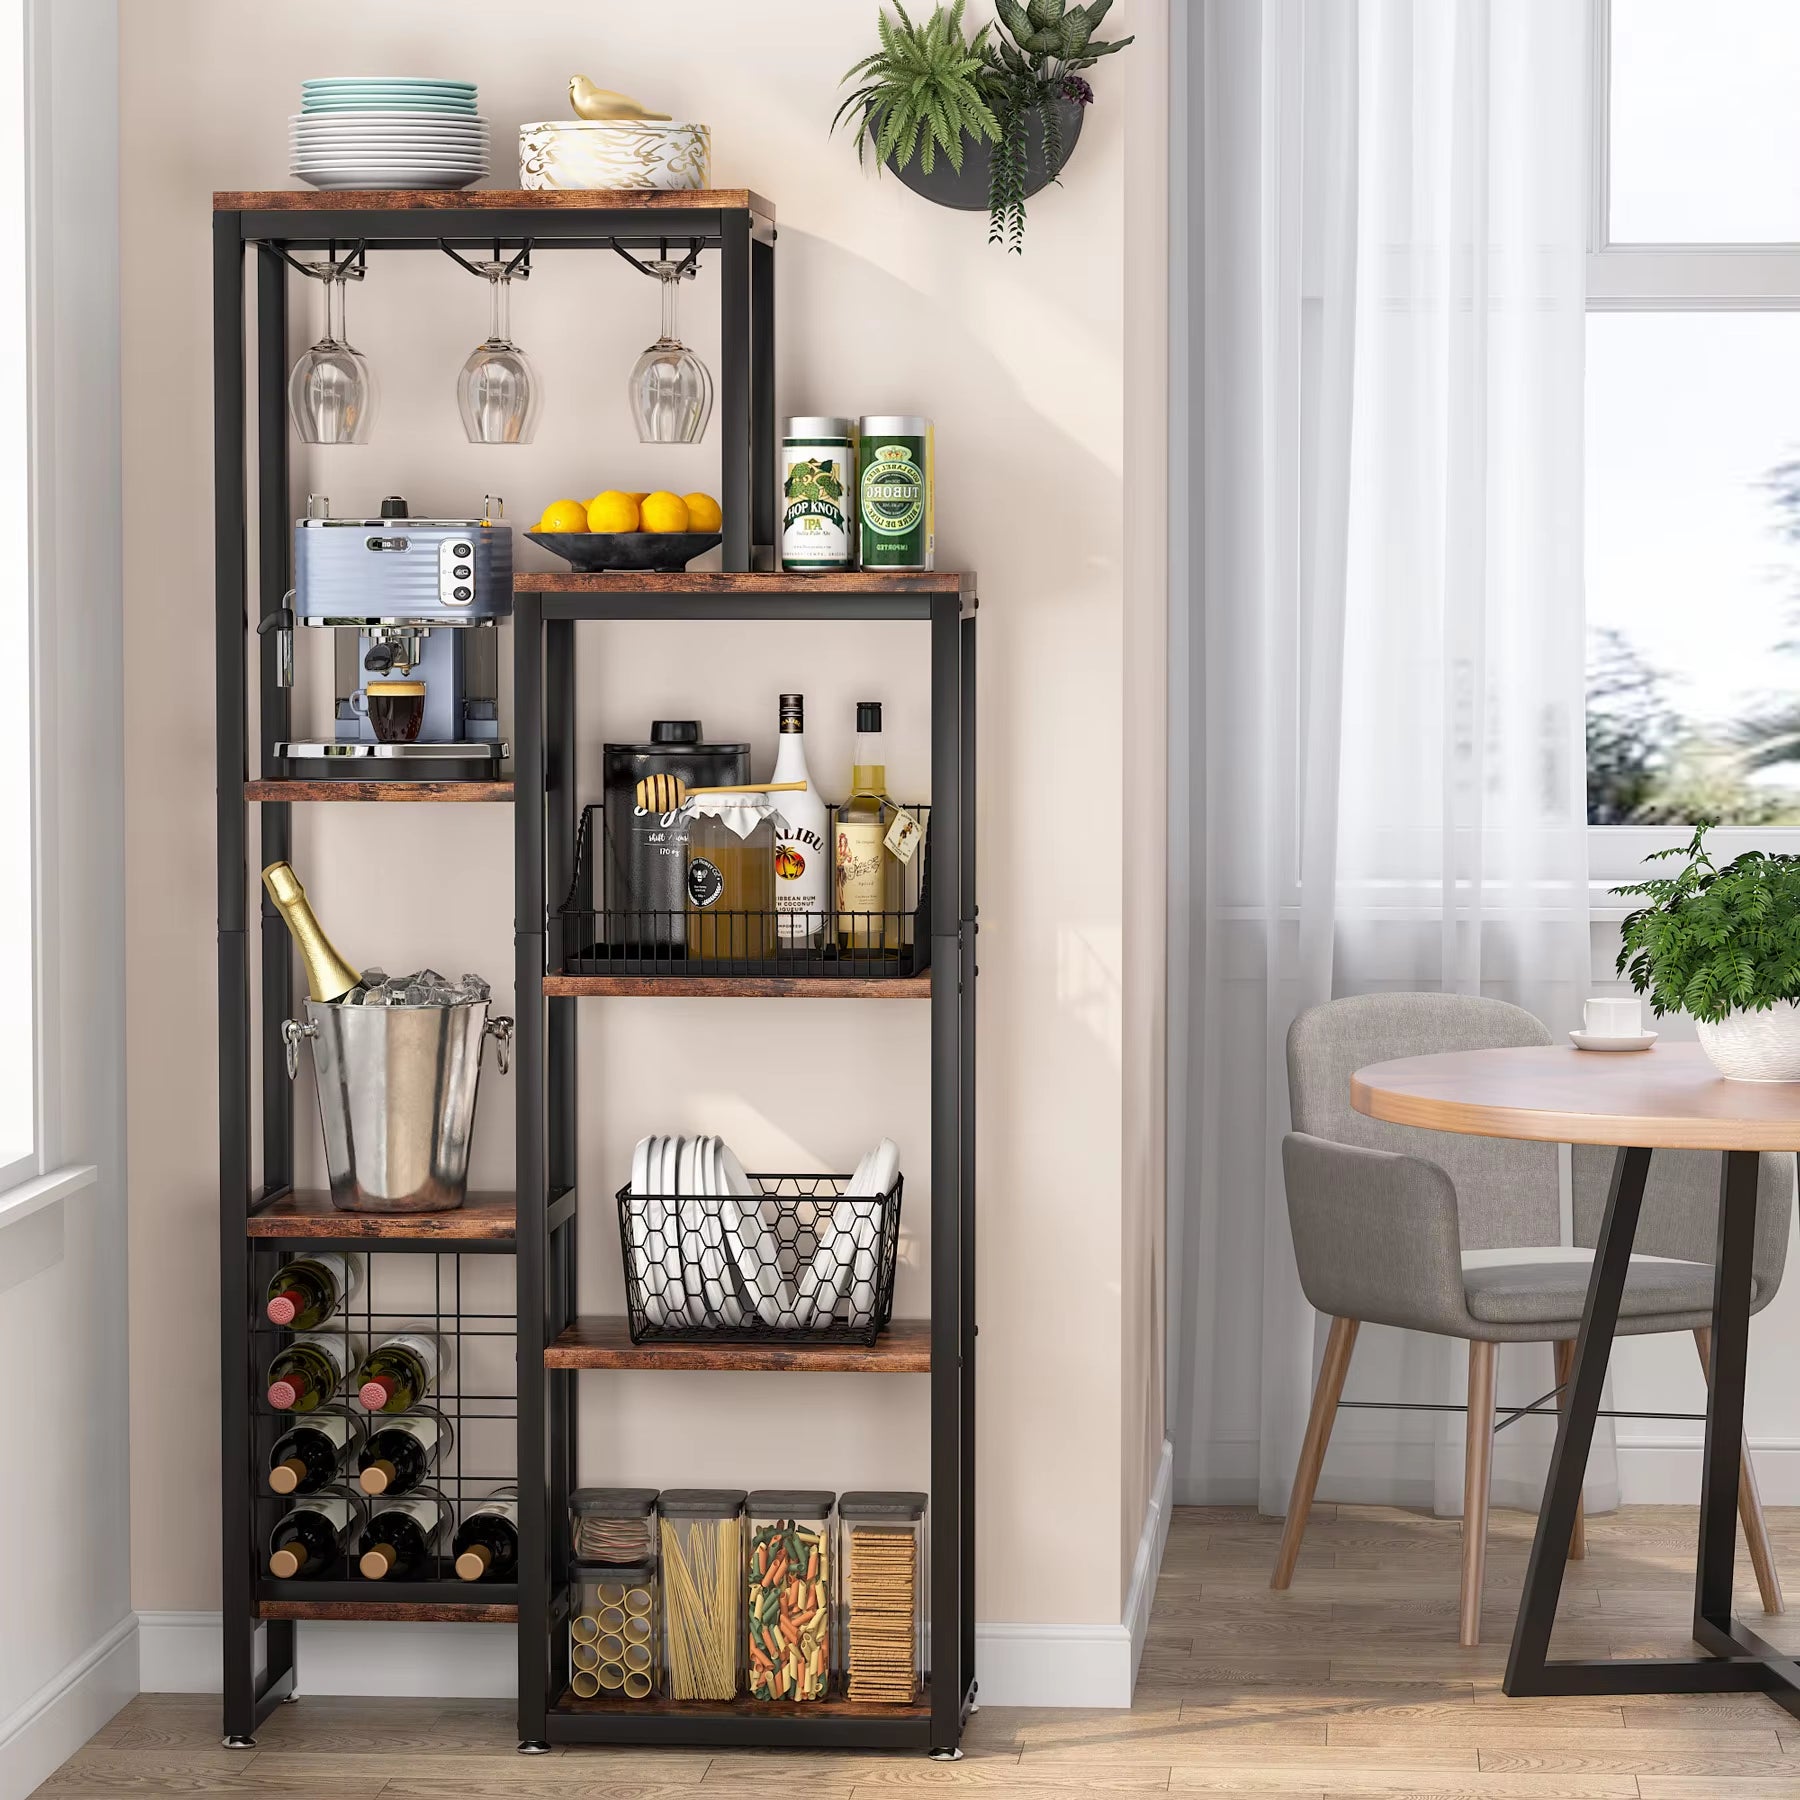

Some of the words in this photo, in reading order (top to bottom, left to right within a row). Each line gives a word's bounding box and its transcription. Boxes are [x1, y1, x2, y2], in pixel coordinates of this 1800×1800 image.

[788, 501, 809, 520] HOP
[811, 501, 838, 519] KNOT
[804, 518, 823, 531] IPA
